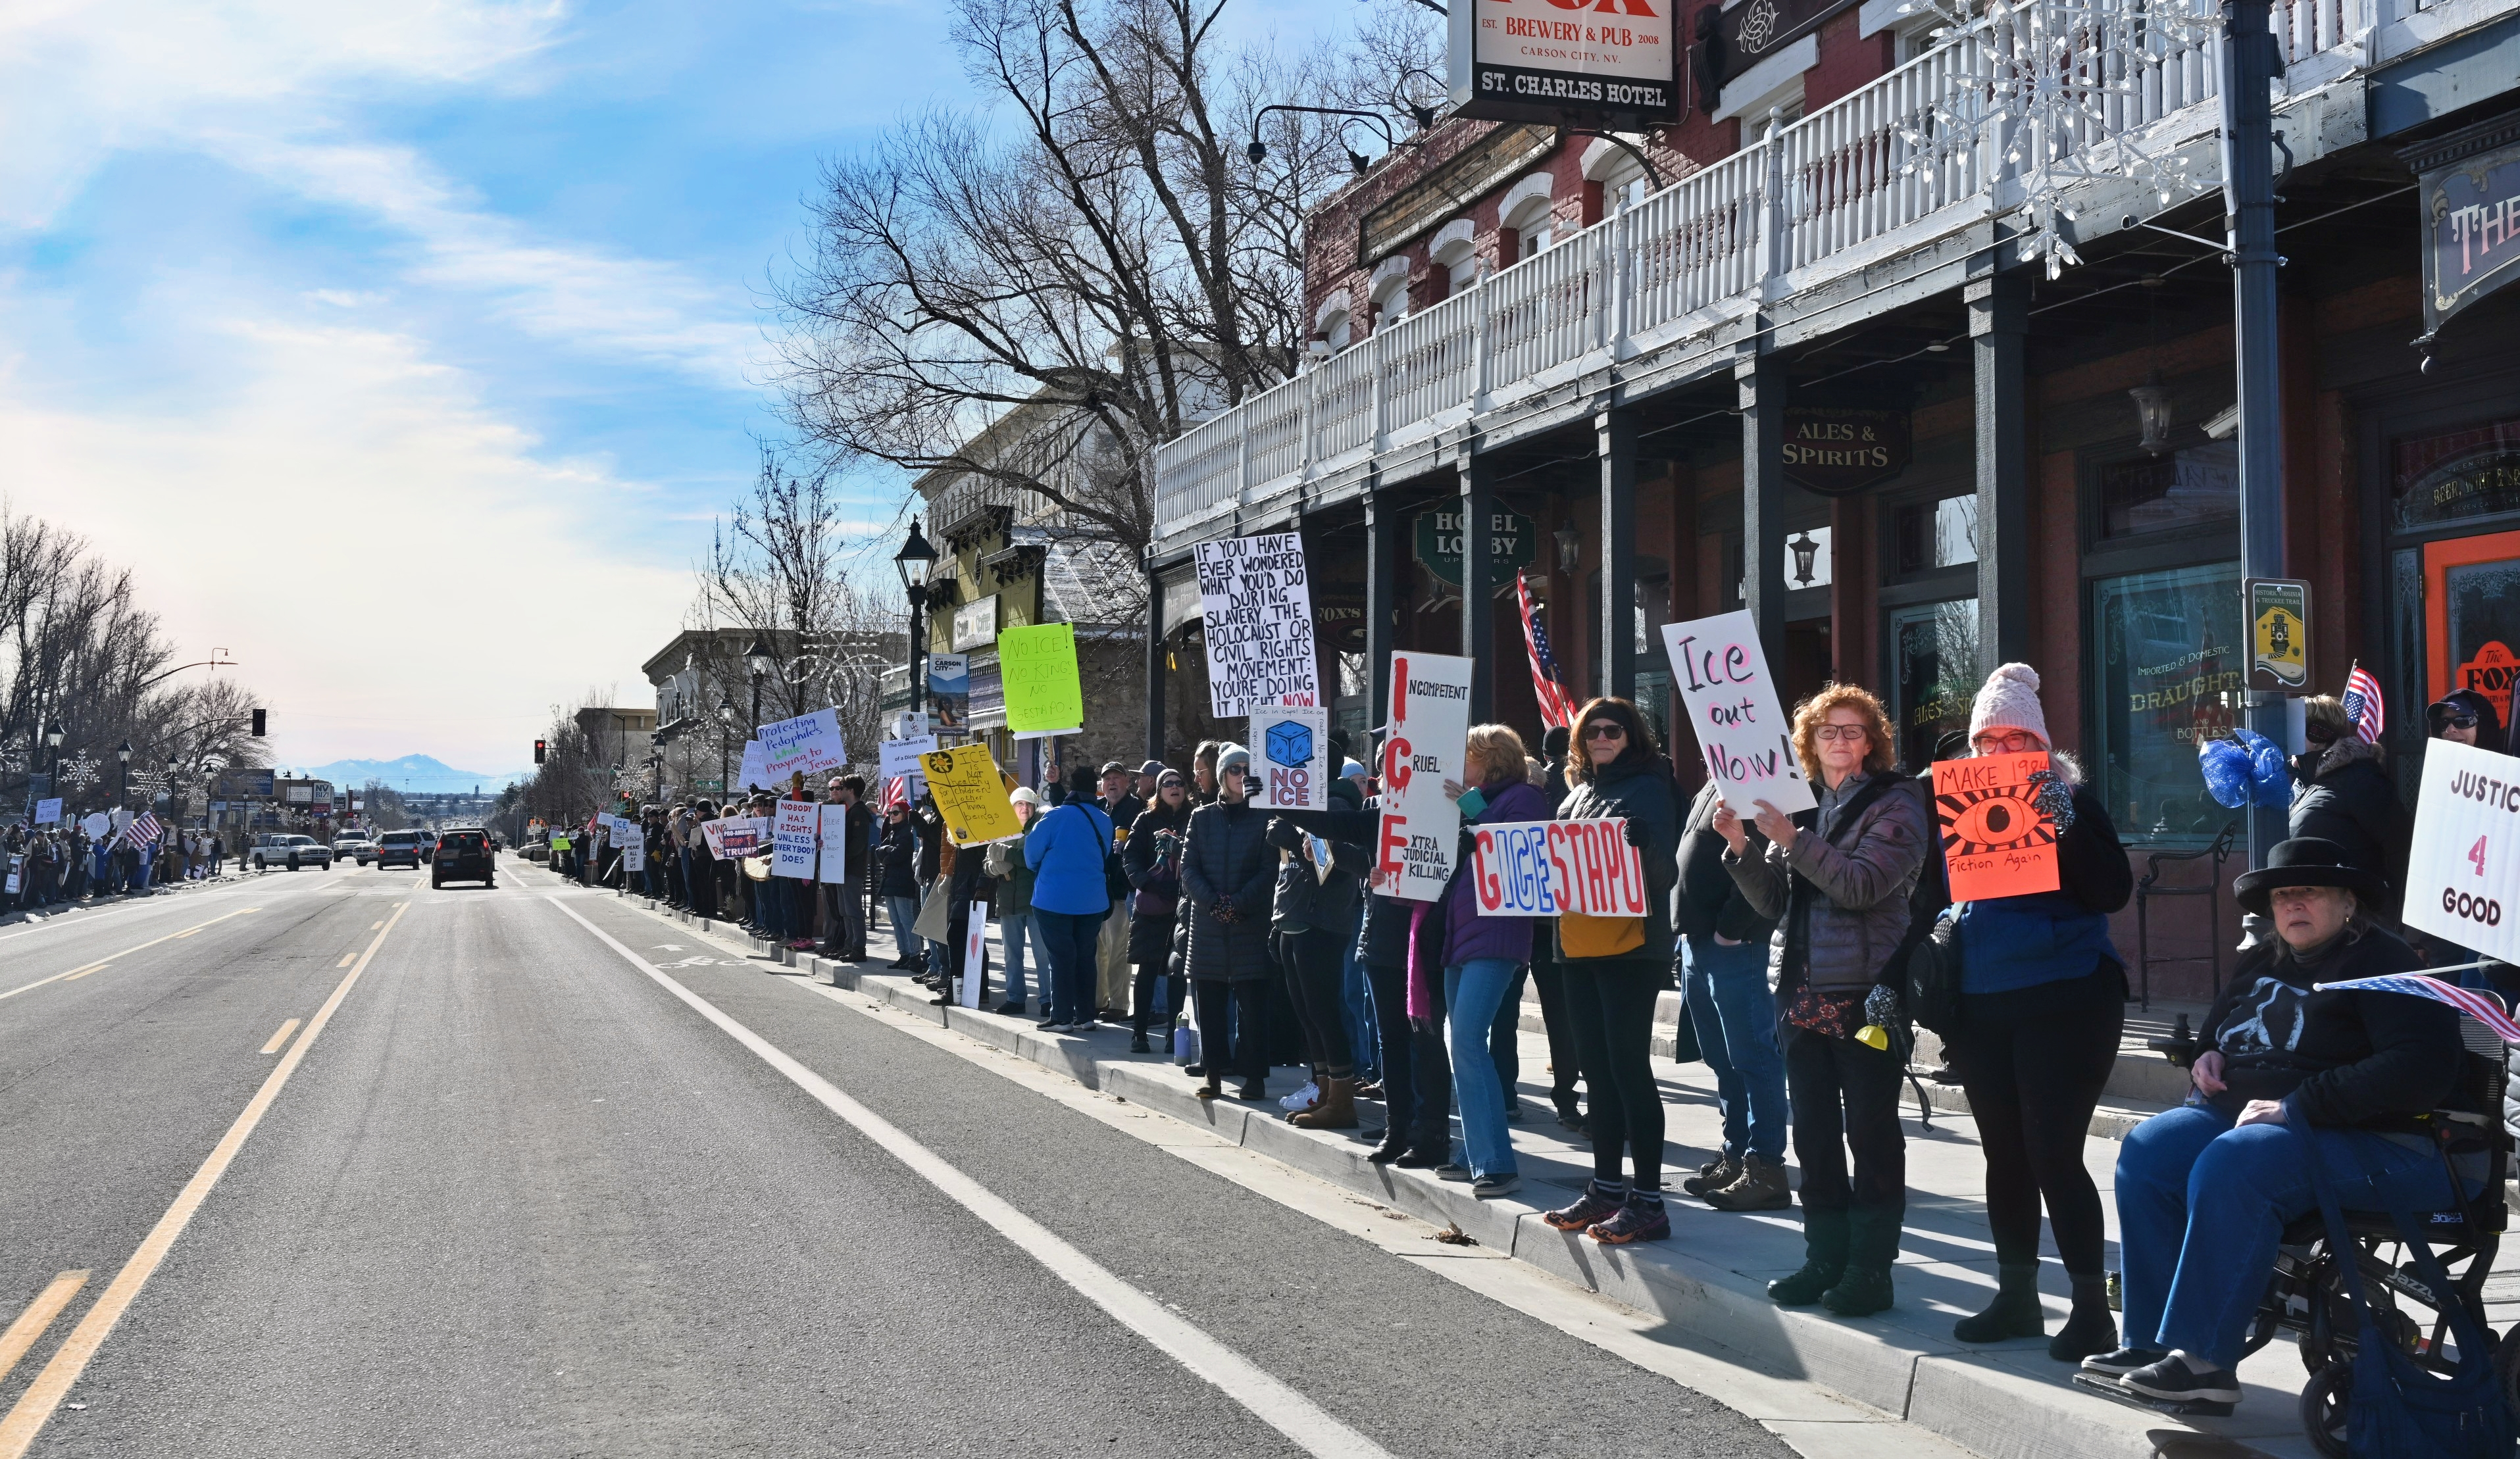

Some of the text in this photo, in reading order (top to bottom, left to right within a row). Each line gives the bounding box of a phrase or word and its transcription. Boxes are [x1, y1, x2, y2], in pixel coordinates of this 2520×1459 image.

[1482, 16, 1659, 47] EST. BREWERY & PUB 2008
[1521, 46, 1621, 64] CARSON CITY, NV.
[1482, 71, 1667, 107] ST. CHARLES HOTEL
[2450, 195, 2520, 275] THE
[1796, 422, 1877, 441] ALES &
[1782, 443, 1888, 467] SPIRITS
[2433, 480, 2462, 507] BEER,
[1436, 512, 1517, 533] HOEL
[1196, 534, 1296, 562] IF YOU HAVE
[1436, 535, 1517, 555] LOBY
[1198, 551, 1303, 579] EVER WONDERED
[1199, 569, 1304, 596] WHAT YOU'D DO
[1229, 587, 1288, 610] DURING
[1165, 597, 1178, 622] THE
[1206, 602, 1303, 629] SLAVERY, THE
[1318, 607, 1361, 624] FOX'S
[1207, 619, 1312, 648] HOLOCAUST OR
[1214, 637, 1311, 663] CIVIL RIGHTS
[2485, 650, 2502, 664] The
[1034, 660, 1073, 680] KINGS
[1227, 656, 1311, 681] MOVEMENT:
[1678, 635, 1757, 693] Ice
[2138, 646, 2230, 676] IMPORTED & DOMESTIC
[1212, 674, 1314, 701] YOU'RE DOING
[2466, 665, 2520, 691] FOX
[2129, 670, 2240, 712] DRAUGHT
[1217, 701, 1230, 717] IT
[1707, 695, 1759, 730] out
[1913, 698, 1942, 727] ALES
[758, 718, 816, 740] Protecting
[766, 726, 823, 751] Pedophiles
[2177, 726, 2228, 739] BOTTLES
[766, 754, 807, 774] Praying
[809, 748, 822, 758] to
[808, 756, 839, 772] Jesus
[957, 750, 990, 764] ICE
[950, 777, 990, 789] healthy
[1271, 768, 1309, 788] NO
[1319, 772, 1324, 781] on
[1940, 758, 2051, 795] MAKE 1984
[939, 787, 949, 798] for
[1270, 787, 1309, 806] ICE
[780, 802, 813, 813] NOBODY
[965, 801, 987, 815] living
[614, 820, 628, 829] ICE
[780, 823, 813, 834] RIGHTS
[788, 814, 805, 823] HAS
[963, 812, 999, 825] beings
[724, 837, 743, 847] STOP
[774, 843, 815, 854] EVERYBODY
[777, 833, 810, 844] UNLESS
[724, 847, 757, 856] TRUMP
[782, 854, 805, 864] DOES
[1402, 848, 1448, 865] JUDICIAL
[2467, 835, 2488, 878] 4
[1408, 863, 1449, 882] KILLING
[1948, 852, 2042, 875] Fiction Again
[2442, 887, 2501, 927] GOOD
[2432, 1214, 2464, 1223] PRIDE
[2384, 1268, 2436, 1304] Jazzy
